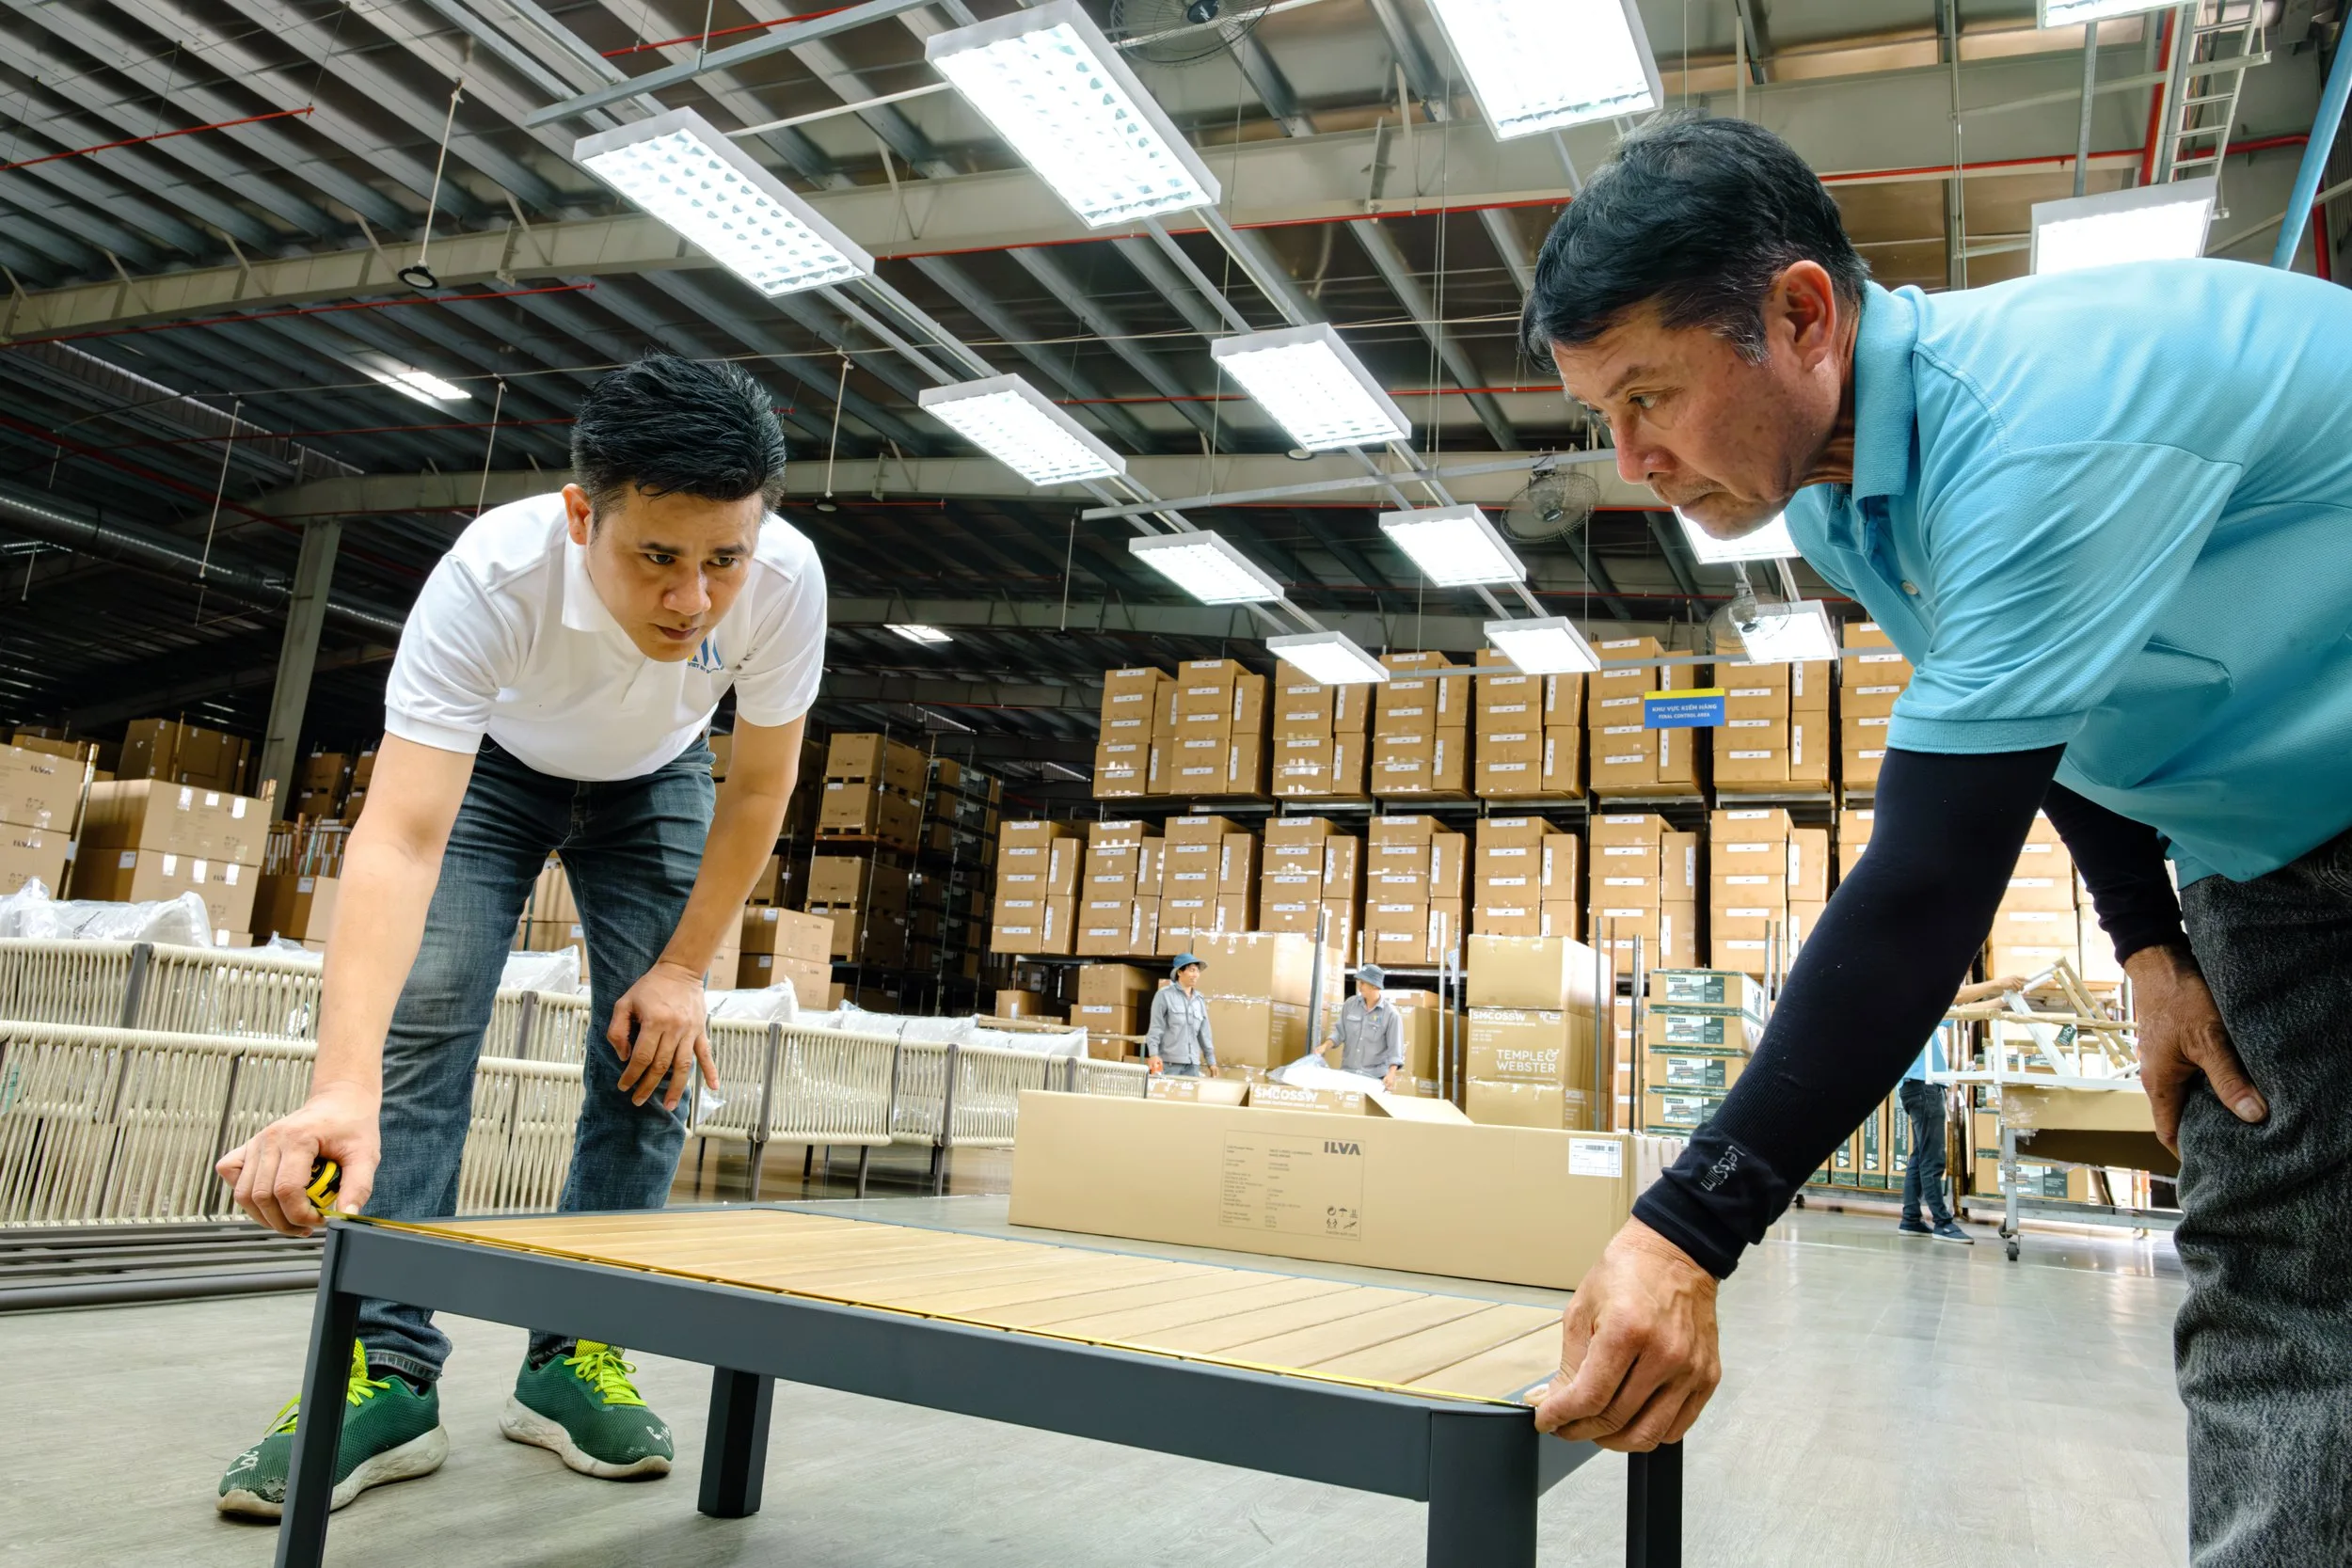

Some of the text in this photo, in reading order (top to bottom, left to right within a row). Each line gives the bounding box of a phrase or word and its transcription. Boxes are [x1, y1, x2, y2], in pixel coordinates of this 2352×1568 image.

[1496, 1060, 1556, 1073] WEBSTER
[1254, 1085, 1319, 1102] SMCOSSW
[1324, 1141, 1361, 1156] ILVA
